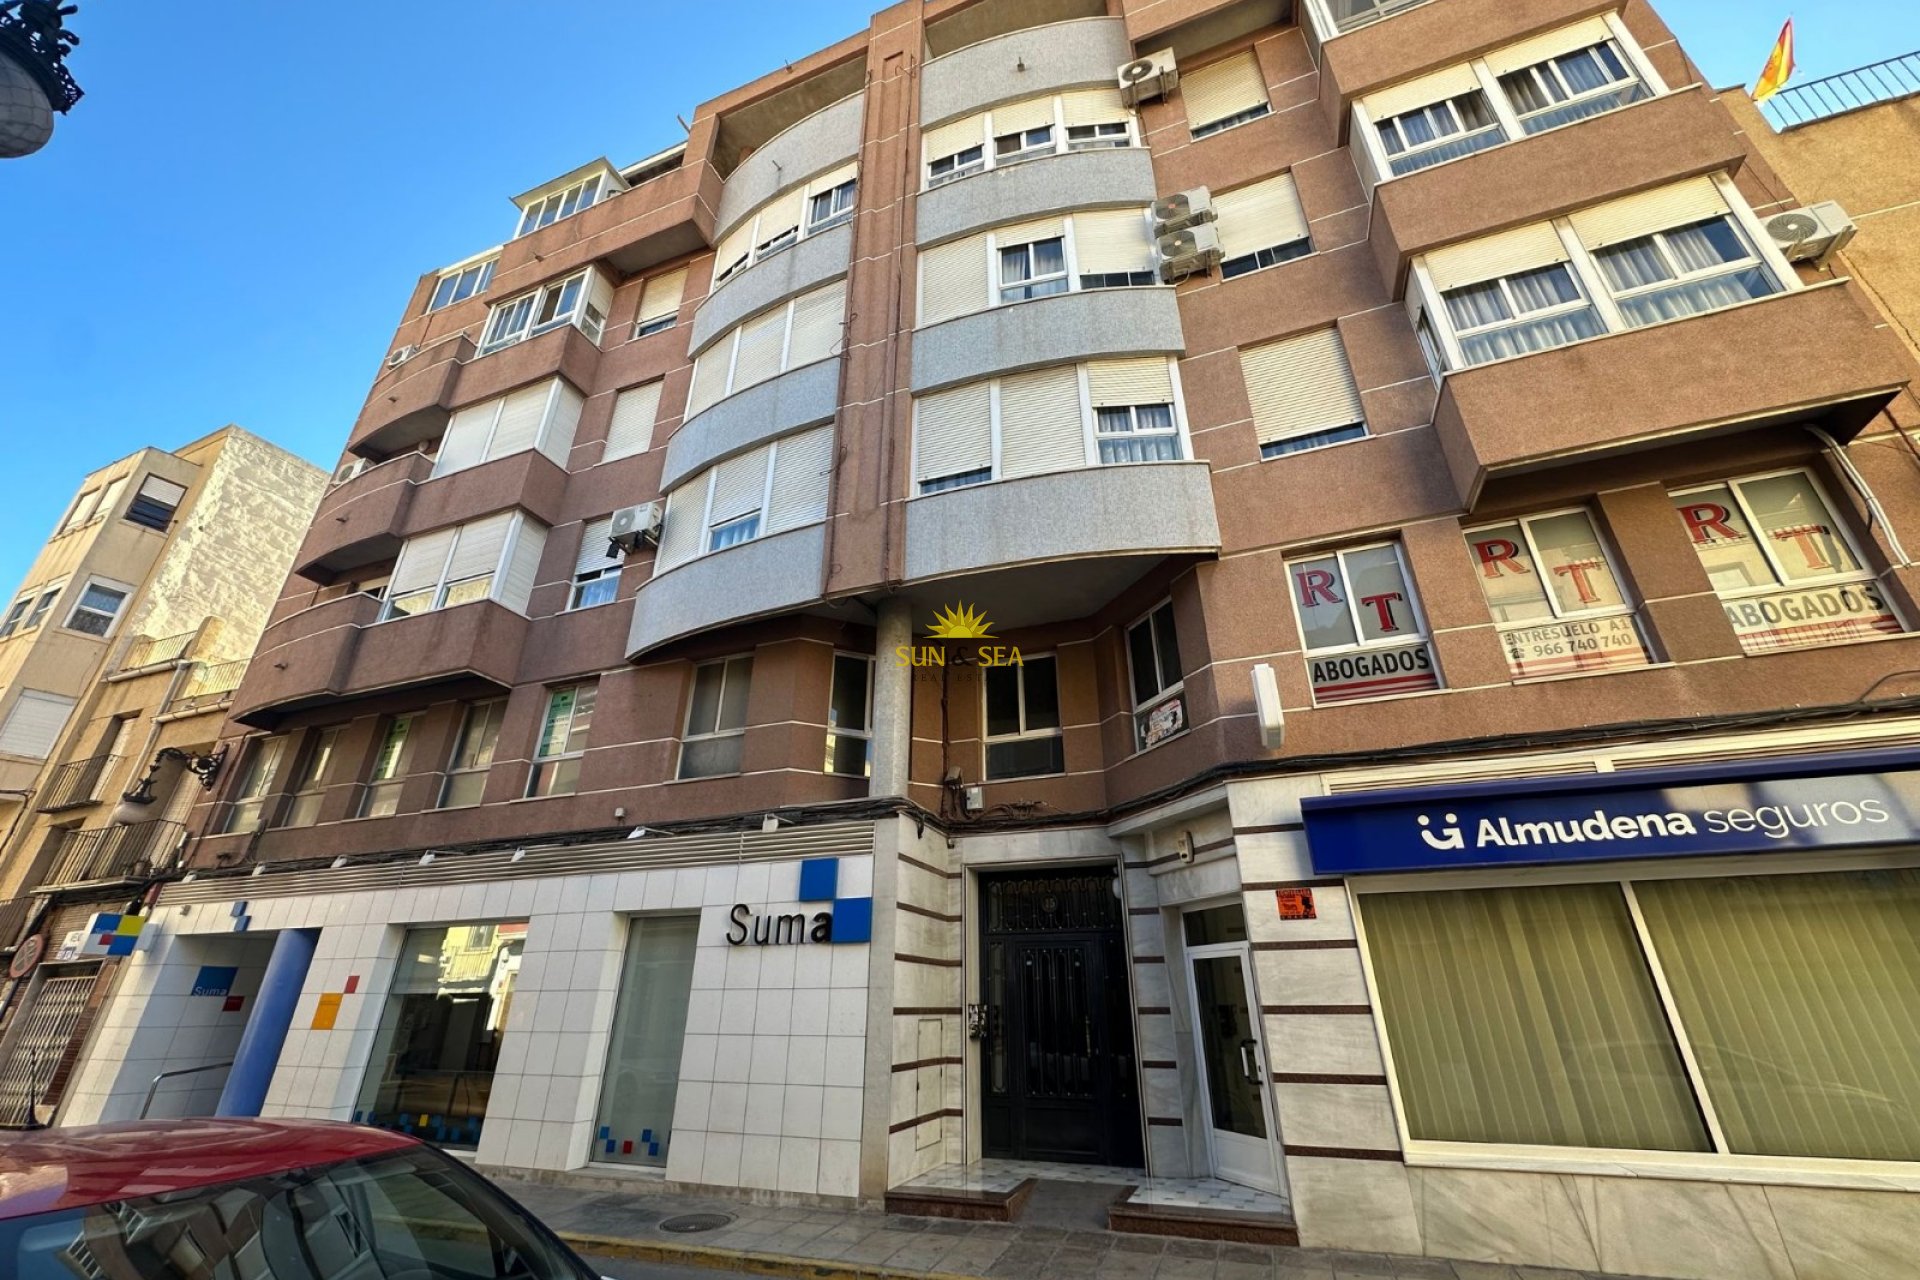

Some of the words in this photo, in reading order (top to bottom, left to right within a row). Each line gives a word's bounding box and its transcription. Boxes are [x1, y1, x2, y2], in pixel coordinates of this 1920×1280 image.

[1677, 502, 1744, 544] R
[1775, 525, 1830, 570] T
[1473, 539, 1530, 579] R
[1553, 560, 1604, 603] T
[1296, 569, 1343, 608] R
[1361, 592, 1403, 632] T
[1724, 586, 1884, 629] ABOGADOS
[1503, 622, 1600, 645] ENTRESUELO
[1534, 643, 1564, 657] 966
[1566, 638, 1598, 652] 740
[1600, 633, 1632, 648] 740
[1313, 647, 1430, 683] ABOGADOS
[1476, 810, 1697, 848] Almudena
[1703, 798, 1889, 839] seguros
[726, 903, 834, 946] Suma
[193, 985, 228, 997] Suma
